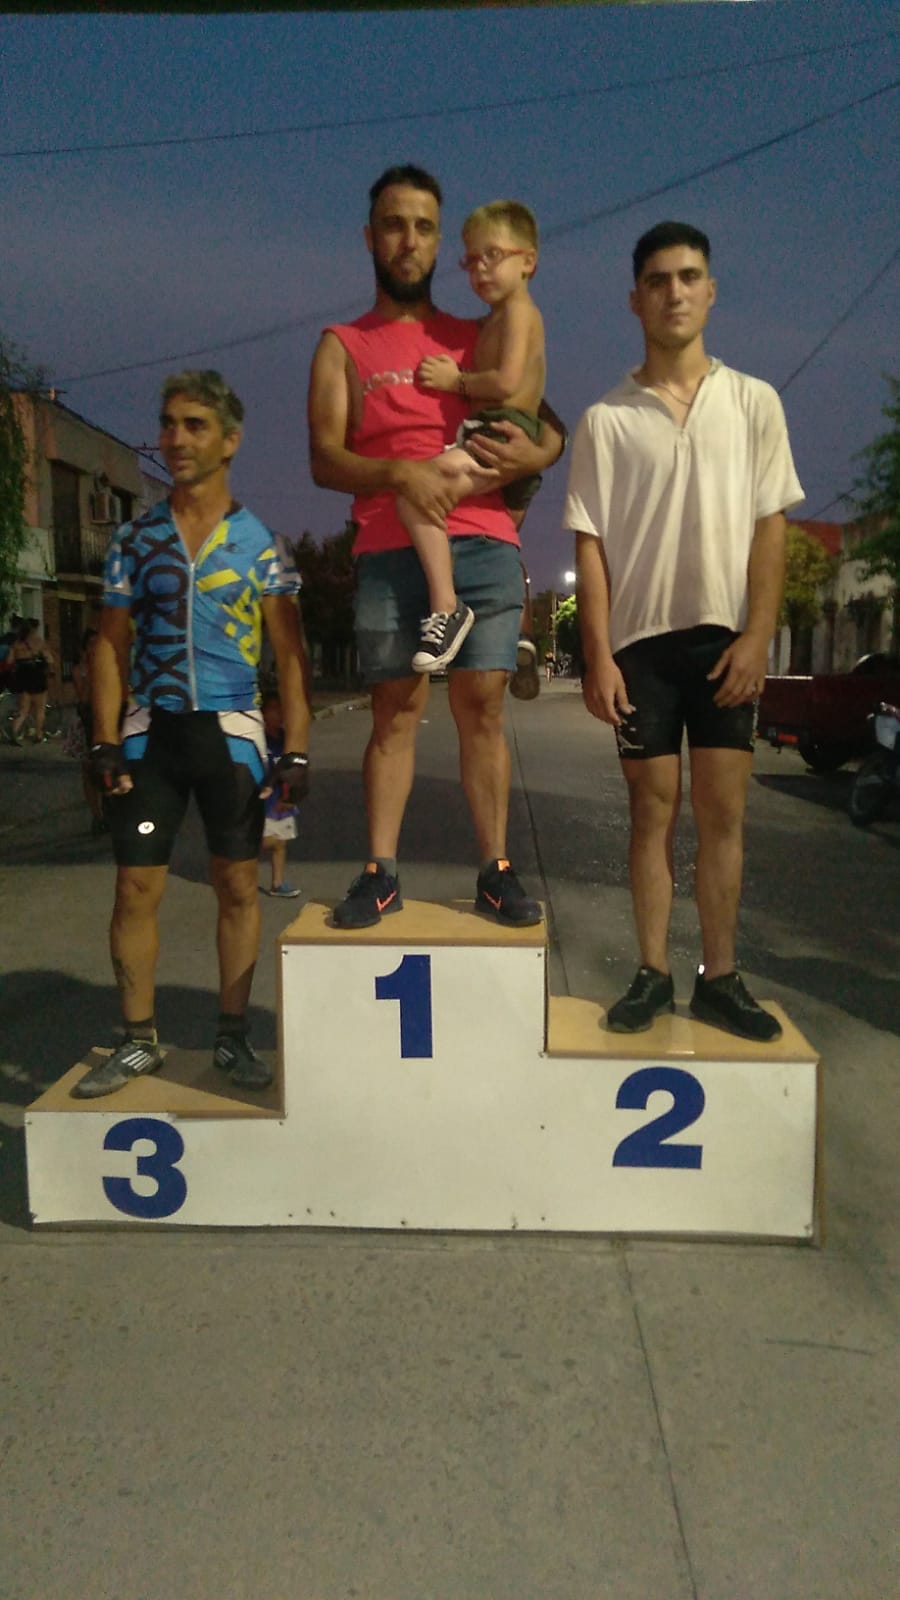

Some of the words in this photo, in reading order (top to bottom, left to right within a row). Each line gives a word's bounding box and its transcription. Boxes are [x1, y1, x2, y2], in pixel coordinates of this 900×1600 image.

[376, 955, 432, 1058] 1
[103, 1119, 187, 1219] 3
[613, 1068, 703, 1169] 2
